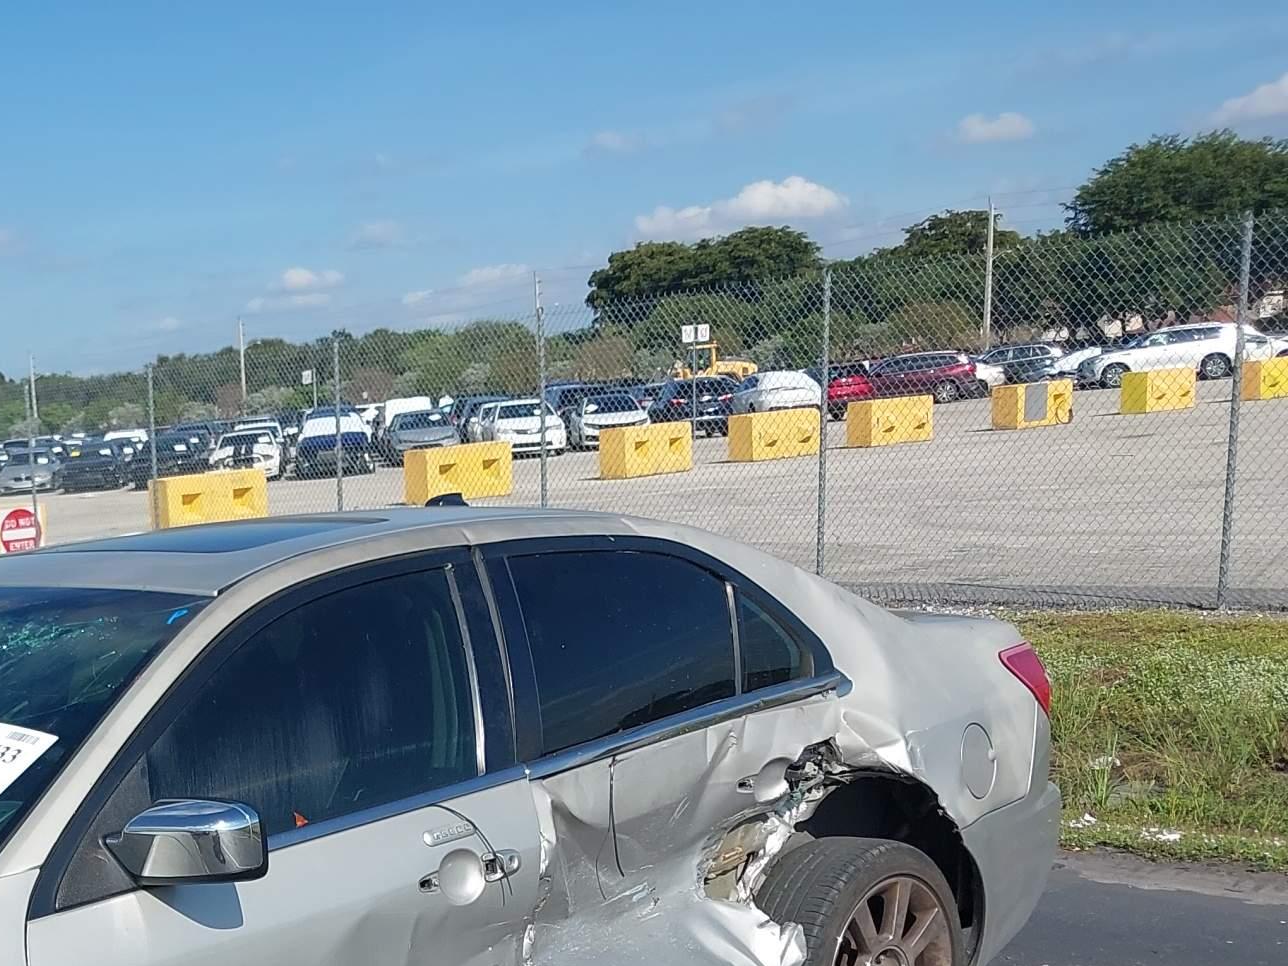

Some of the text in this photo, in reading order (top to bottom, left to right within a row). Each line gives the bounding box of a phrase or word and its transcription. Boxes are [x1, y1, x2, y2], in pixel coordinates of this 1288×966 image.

[4, 516, 35, 530] DO NOT
[9, 539, 35, 552] ENTER
